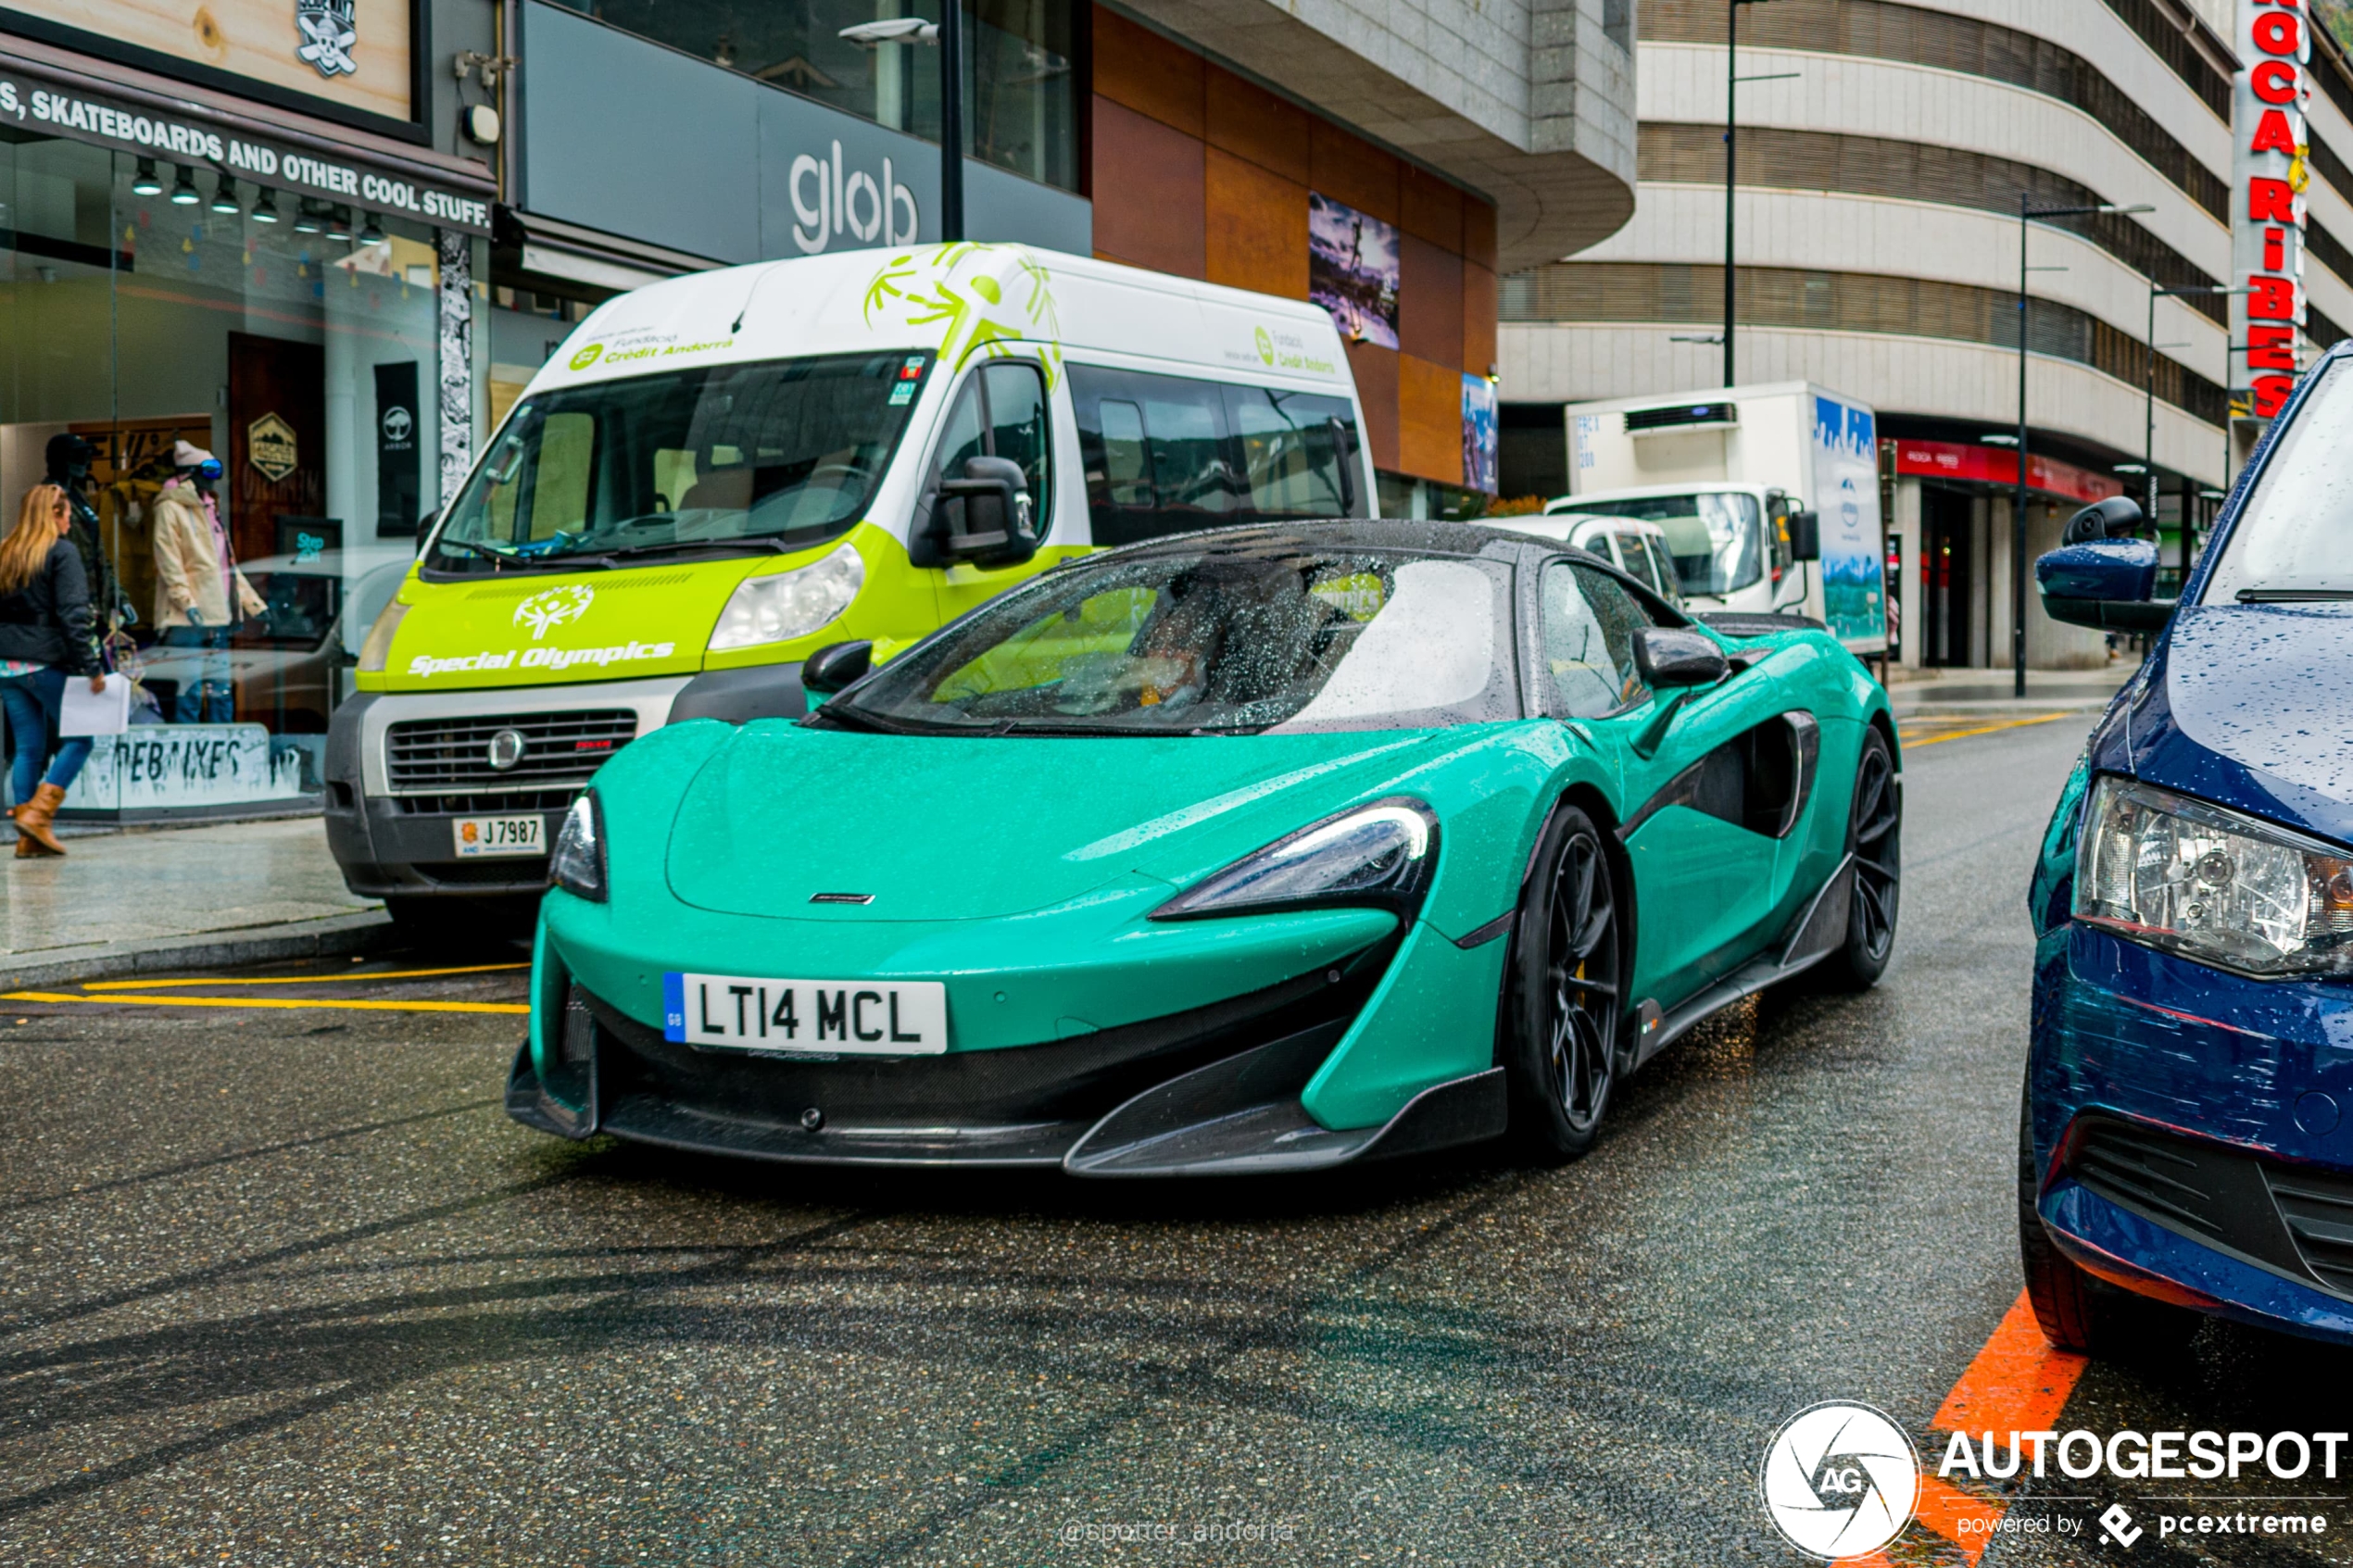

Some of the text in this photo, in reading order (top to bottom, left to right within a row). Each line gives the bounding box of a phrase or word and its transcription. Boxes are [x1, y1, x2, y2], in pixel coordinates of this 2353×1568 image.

[2251, 0, 2300, 154] OCA
[31, 90, 224, 162] SKATEBOARDS
[229, 139, 277, 175] AND
[283, 154, 359, 196] OTHER
[362, 174, 420, 212] COOL
[422, 191, 491, 229] STUFF.
[790, 139, 918, 254] glob
[408, 641, 675, 678] Special Olympics
[484, 821, 537, 844] J 7987
[700, 984, 921, 1043] LT14 MCL
